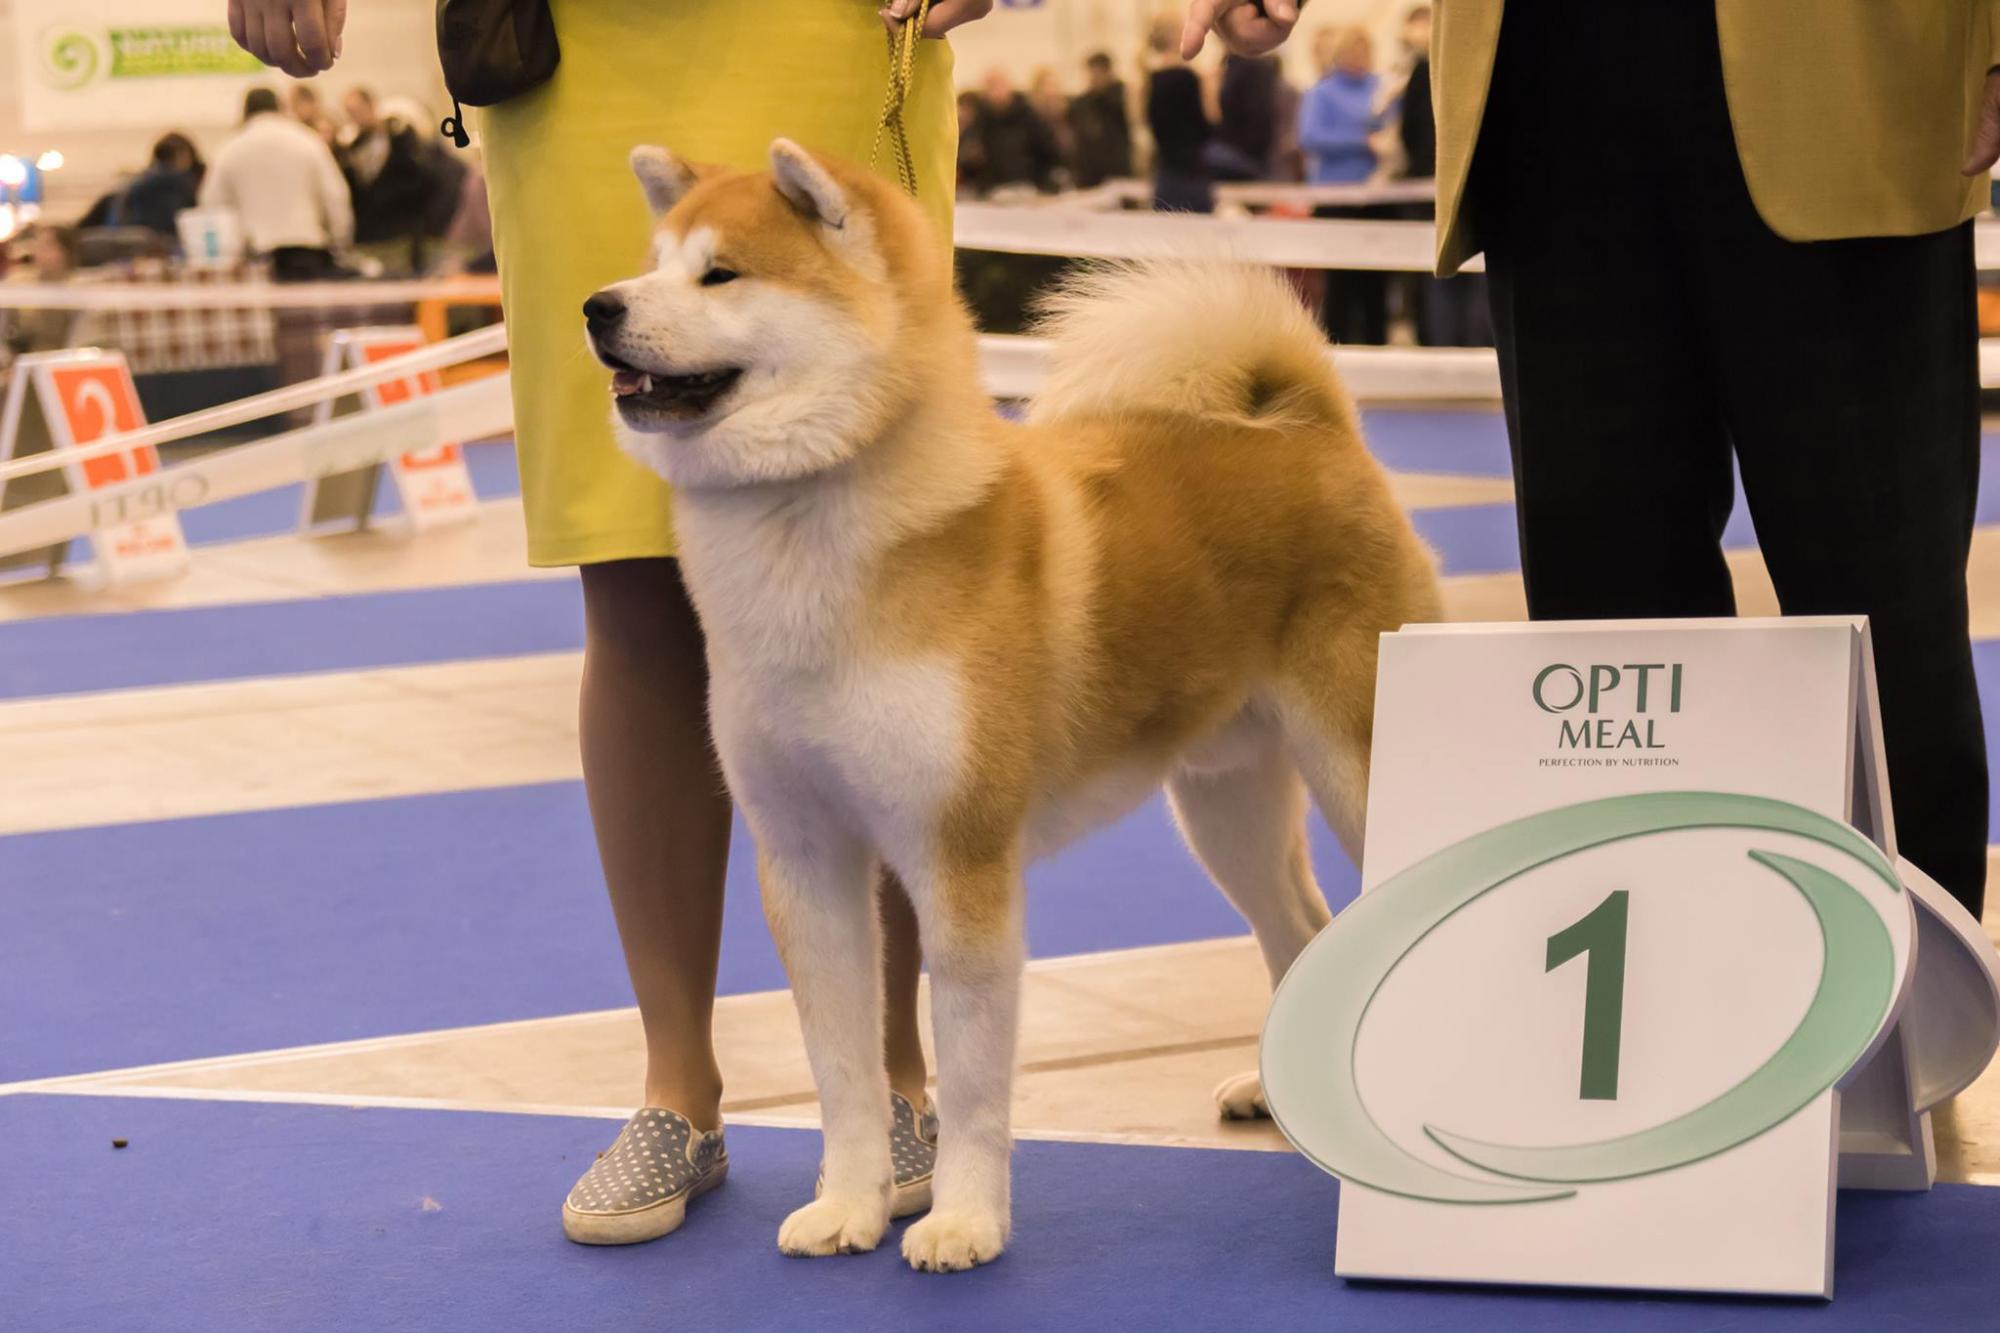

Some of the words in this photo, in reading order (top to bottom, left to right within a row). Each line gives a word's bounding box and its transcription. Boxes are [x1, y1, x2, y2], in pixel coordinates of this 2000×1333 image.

[1532, 663, 1682, 713] OPTI
[1558, 719, 1666, 749] MEAL
[1539, 757, 1602, 767] PERFECTION
[1605, 757, 1618, 767] BY
[1622, 757, 1679, 767] NUTRITION
[1545, 890, 1629, 1100] 1
